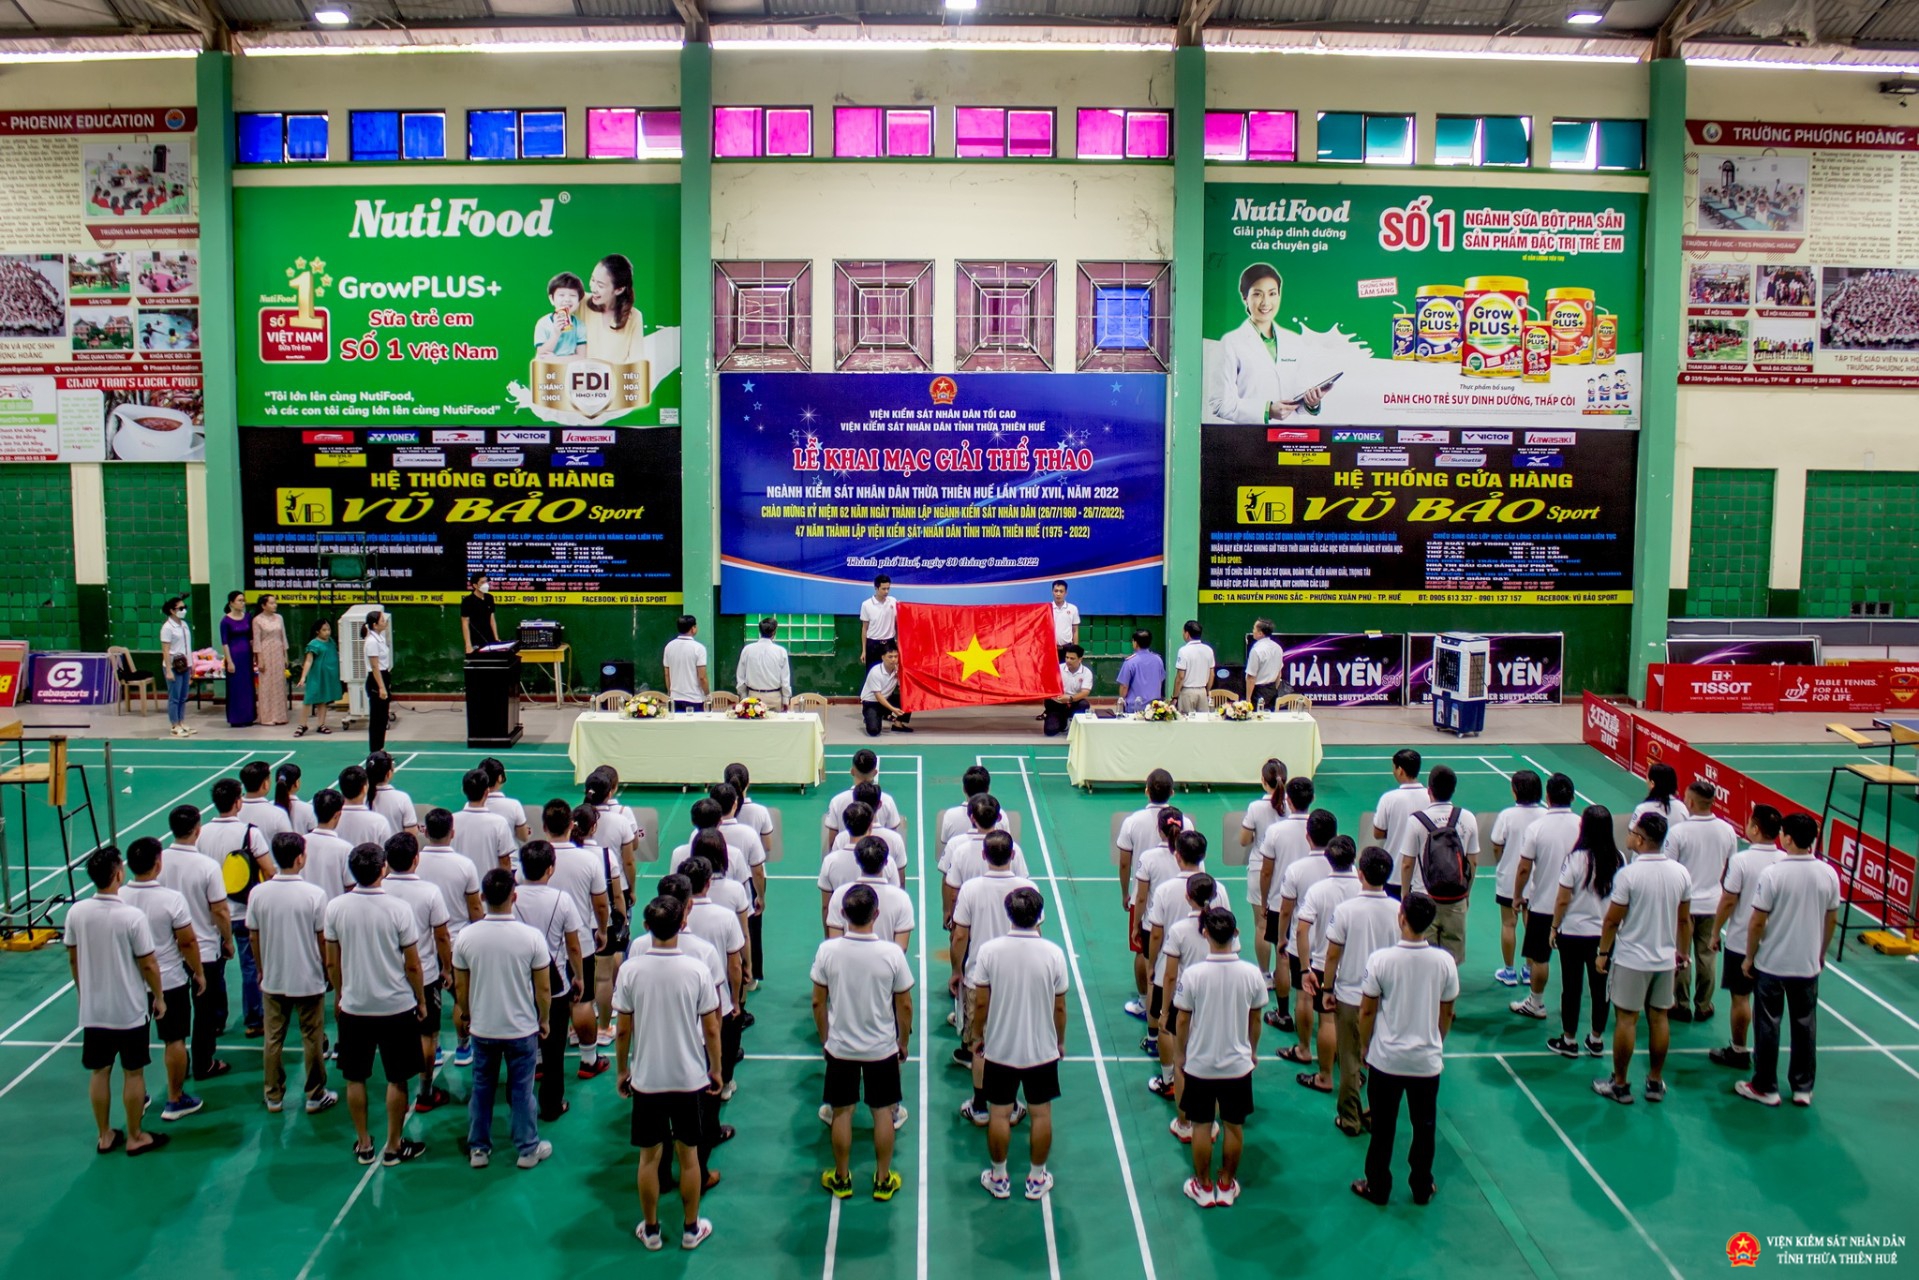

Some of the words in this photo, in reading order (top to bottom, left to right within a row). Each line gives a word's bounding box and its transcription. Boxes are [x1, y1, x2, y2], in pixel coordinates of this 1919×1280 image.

[10, 115, 72, 130] PHOENIX
[76, 114, 154, 129] EDUCATION
[1794, 128, 1852, 144] PHƯỢNG
[1855, 130, 1905, 145] HOÀNG
[1231, 198, 1351, 222] NutiFood
[348, 197, 554, 238] NutiFood
[1381, 198, 1430, 248] SỐ
[1436, 212, 1452, 249] 1
[1465, 210, 1510, 227] NGÀNH
[1513, 210, 1538, 227] SỮA
[1541, 211, 1566, 232] BỘT
[1568, 214, 1593, 228] PHA
[1233, 226, 1254, 236] Giải
[1256, 227, 1283, 238] pháp
[1285, 227, 1310, 237] dinh
[1311, 227, 1347, 240] dưỡng
[1251, 239, 1269, 250] của
[1271, 240, 1309, 252] chuyên
[1312, 241, 1328, 253] gia
[1465, 230, 1490, 247] SẢN
[1493, 231, 1527, 248] PHẨM
[1531, 235, 1554, 252] ĐẶC
[1557, 236, 1576, 253] TRỊ
[1579, 233, 1600, 250] TRẺ
[1603, 237, 1621, 250] EM
[338, 275, 502, 299] GrowPLUS+
[369, 309, 406, 327] Sữa
[412, 307, 439, 327] trẻ
[443, 314, 474, 327] em
[1423, 308, 1454, 318] Grow
[1473, 306, 1514, 319] Grow
[1555, 311, 1580, 319] Grow
[269, 313, 286, 327] SỐ
[1420, 320, 1459, 330] PLUS+
[1552, 319, 1584, 327] PLUS+
[1469, 321, 1520, 335] PLUS+
[266, 330, 293, 345] VIỆT
[295, 331, 324, 343] NAM
[340, 330, 380, 361] SỐ
[387, 338, 404, 361] 1
[408, 341, 449, 364] Việt
[453, 343, 498, 361] Nam
[137, 377, 170, 388] LOCAL
[171, 376, 198, 387] FOOD
[572, 372, 609, 390] FDI
[290, 390, 307, 401] lớn
[310, 390, 327, 401] lên
[329, 390, 356, 403] cùng
[359, 390, 415, 403] NutiFood,
[1383, 392, 1410, 404] DÀNH
[1412, 394, 1432, 404] CHO
[1433, 392, 1450, 404] TRẺ
[1451, 395, 1469, 405] SUY
[1472, 395, 1495, 405] DINH
[1496, 393, 1533, 407] DƯỠNG,
[1535, 393, 1558, 406] THẤP
[1560, 394, 1575, 406] CÒI
[264, 404, 278, 415] và
[280, 404, 298, 415] các
[301, 406, 321, 415] con
[324, 404, 339, 415] tôi
[342, 404, 369, 417] cũng
[372, 404, 390, 415] lớn
[393, 404, 409, 415] lên
[412, 404, 440, 417] cùng
[869, 408, 890, 420] VIỆN
[892, 407, 915, 419] KIỂM
[916, 408, 934, 419] SÁT
[936, 408, 961, 419] NHÂN
[962, 408, 980, 419] DÂN
[983, 407, 996, 419] TỐI
[999, 409, 1016, 419] CAO
[840, 421, 860, 433] VIỆN
[863, 420, 885, 432] KIỂM
[887, 421, 904, 432] SÁT
[906, 421, 931, 432] NHÂN
[933, 421, 953, 432] DÂN
[955, 420, 974, 432] TỈNH
[1001, 421, 1026, 432] THIÊN
[1028, 420, 1046, 432] HUẾ
[387, 433, 415, 441] YONEX
[1352, 433, 1381, 441] YONEX
[793, 437, 819, 471] LỄ
[824, 448, 880, 471] KHAI
[884, 448, 930, 477] MẠC
[935, 439, 982, 471] GIẢI
[986, 435, 1029, 471] THỂ
[1033, 448, 1094, 471] THAO
[371, 468, 401, 490] HỆ
[408, 467, 489, 488] THỐNG
[493, 467, 543, 488] CỬA
[548, 469, 615, 488] HÀNG
[1334, 468, 1364, 489] HỆ
[1370, 467, 1449, 488] THỐNG
[1455, 467, 1505, 488] CỬA
[1509, 469, 1573, 488] HÀNG
[767, 483, 802, 499] NGÀNH
[805, 483, 831, 499] KIỂM
[834, 483, 854, 499] SÁT
[856, 484, 885, 499] NHÂN
[888, 484, 909, 499] DÂN
[912, 484, 938, 499] THỪA
[941, 484, 971, 499] THIÊN
[974, 482, 995, 499] HUẾ
[996, 482, 1016, 499] LẦN
[1019, 485, 1040, 499] THỨ
[1041, 486, 1065, 500] XVII,
[1067, 484, 1091, 499] NĂM
[1094, 486, 1119, 499] 2022
[341, 490, 434, 524] VŨ
[444, 491, 589, 524] BẢO
[588, 503, 645, 522] Sport
[1303, 490, 1396, 521] VŨ
[1406, 491, 1547, 522] BẢO
[1547, 504, 1600, 521] Sport
[1597, 593, 1618, 601] SPORT
[1290, 655, 1330, 686] HẢI
[1336, 657, 1382, 686] YẾN
[1497, 657, 1542, 686] YẾN
[1691, 682, 1752, 694] TISSOT
[1814, 678, 1841, 686] TABLE
[1843, 679, 1878, 687] TENNIS.
[1338, 693, 1388, 701] SHUTTLECOCK
[1832, 694, 1854, 702] LIFE.
